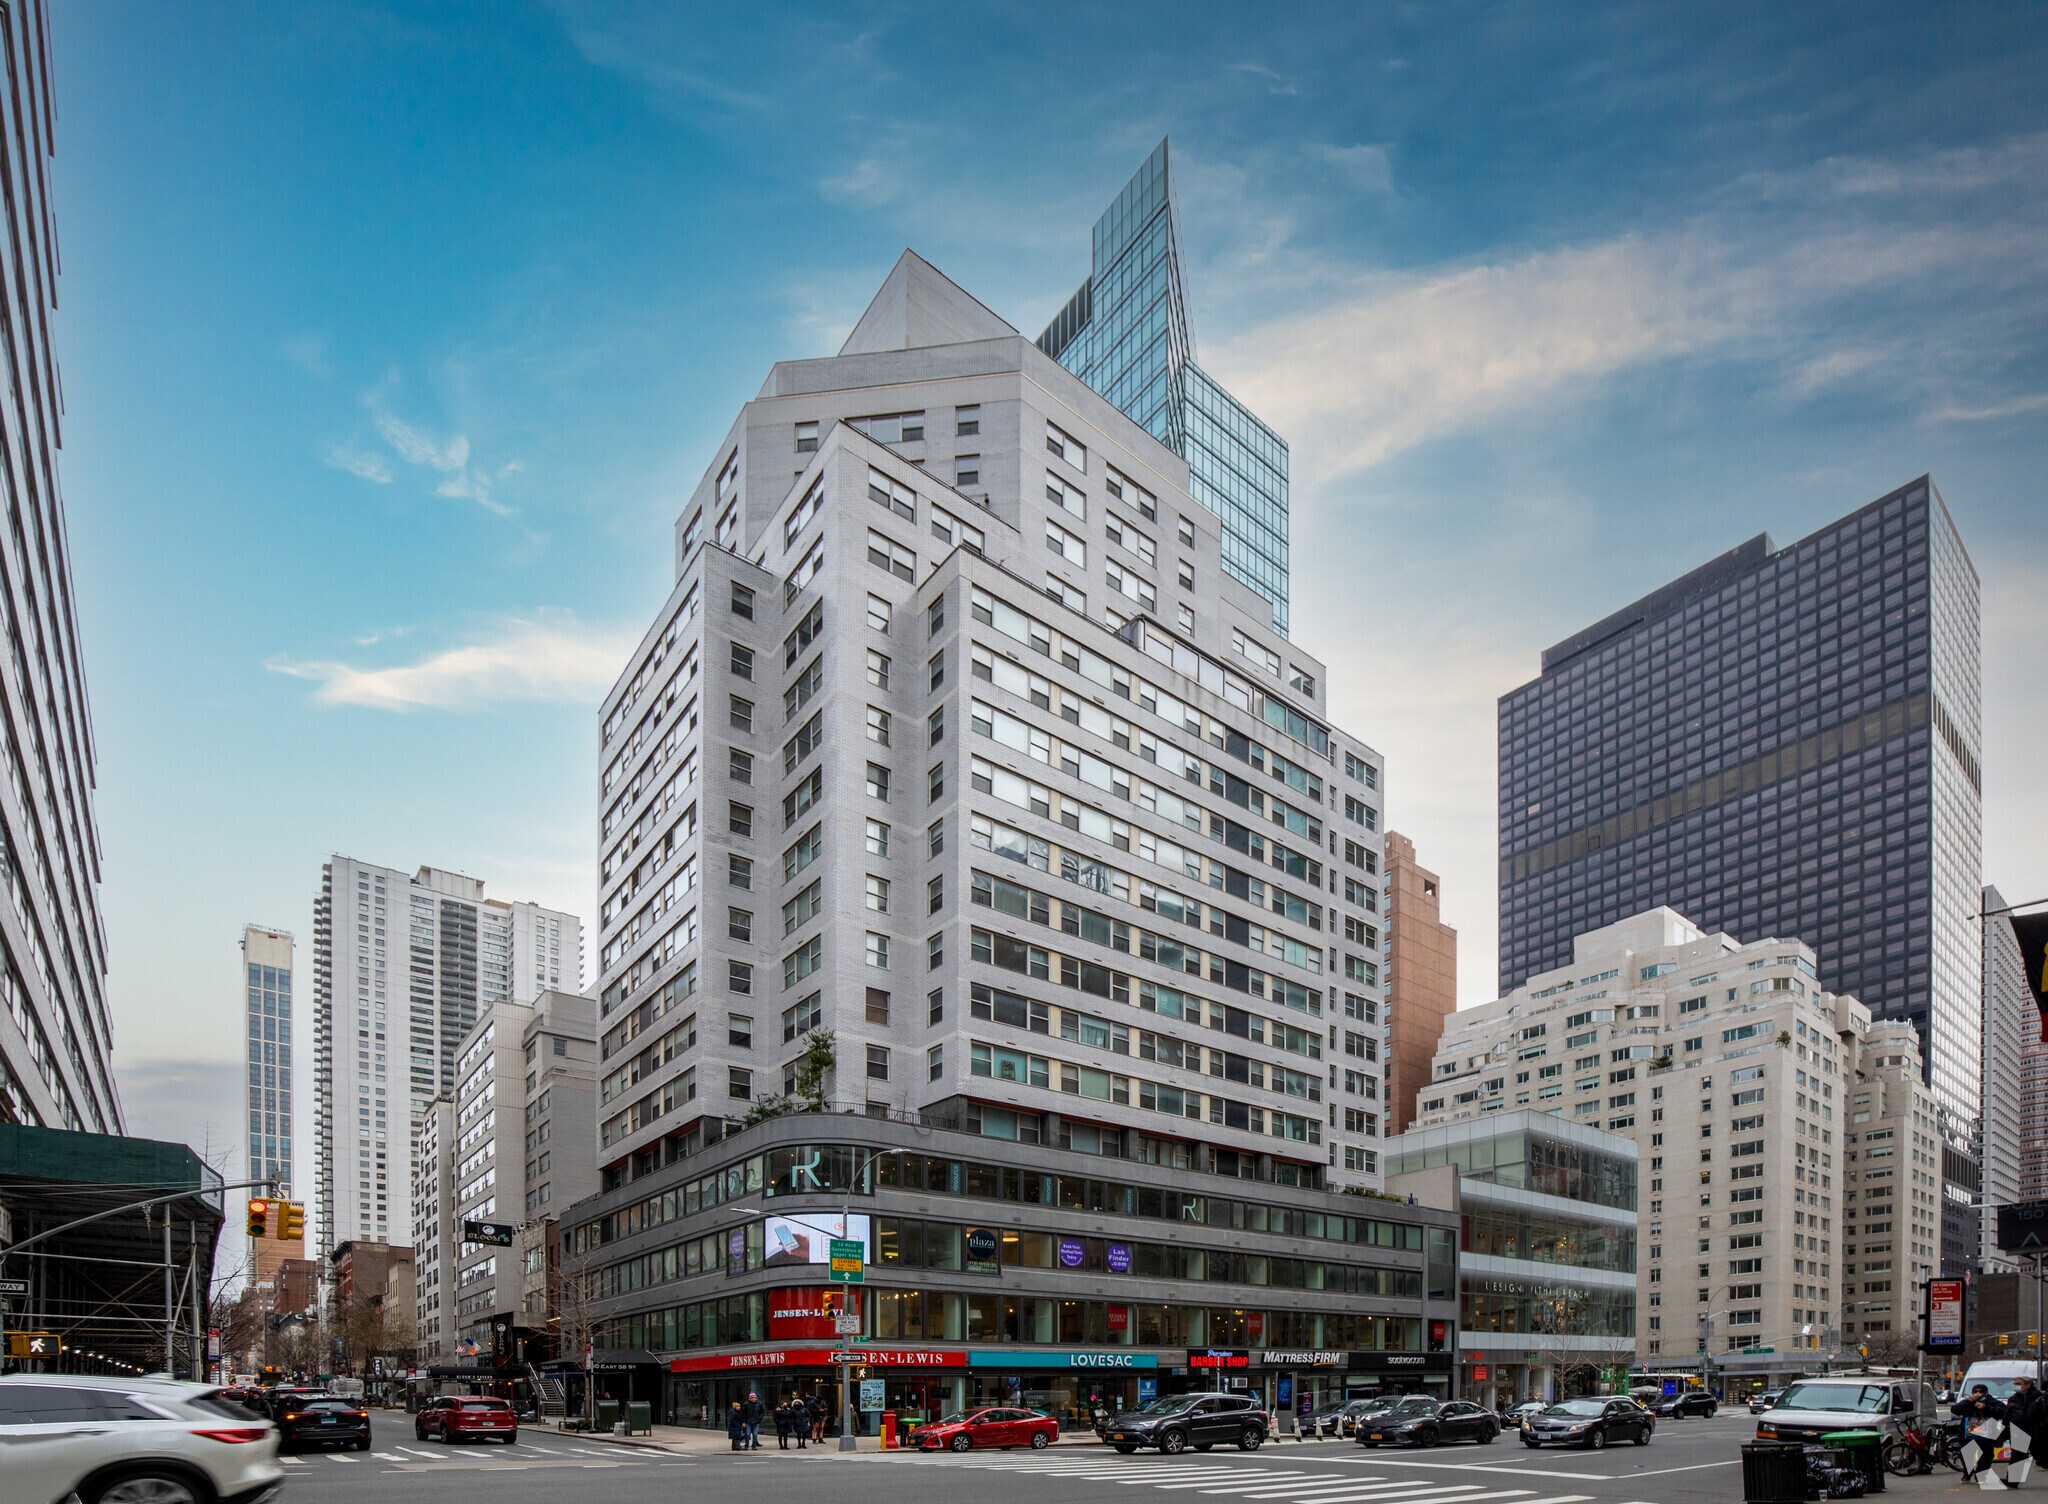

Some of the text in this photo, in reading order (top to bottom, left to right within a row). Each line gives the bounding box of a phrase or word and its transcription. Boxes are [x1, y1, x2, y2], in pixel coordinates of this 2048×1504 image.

[970, 1235, 995, 1248] plaza
[730, 1352, 786, 1367] JENSEN-LEWIS
[828, 1351, 943, 1364] JSEN-LEWIS
[1070, 1354, 1132, 1366] LOVESAC
[1190, 1356, 1249, 1368] BARBER SHOP
